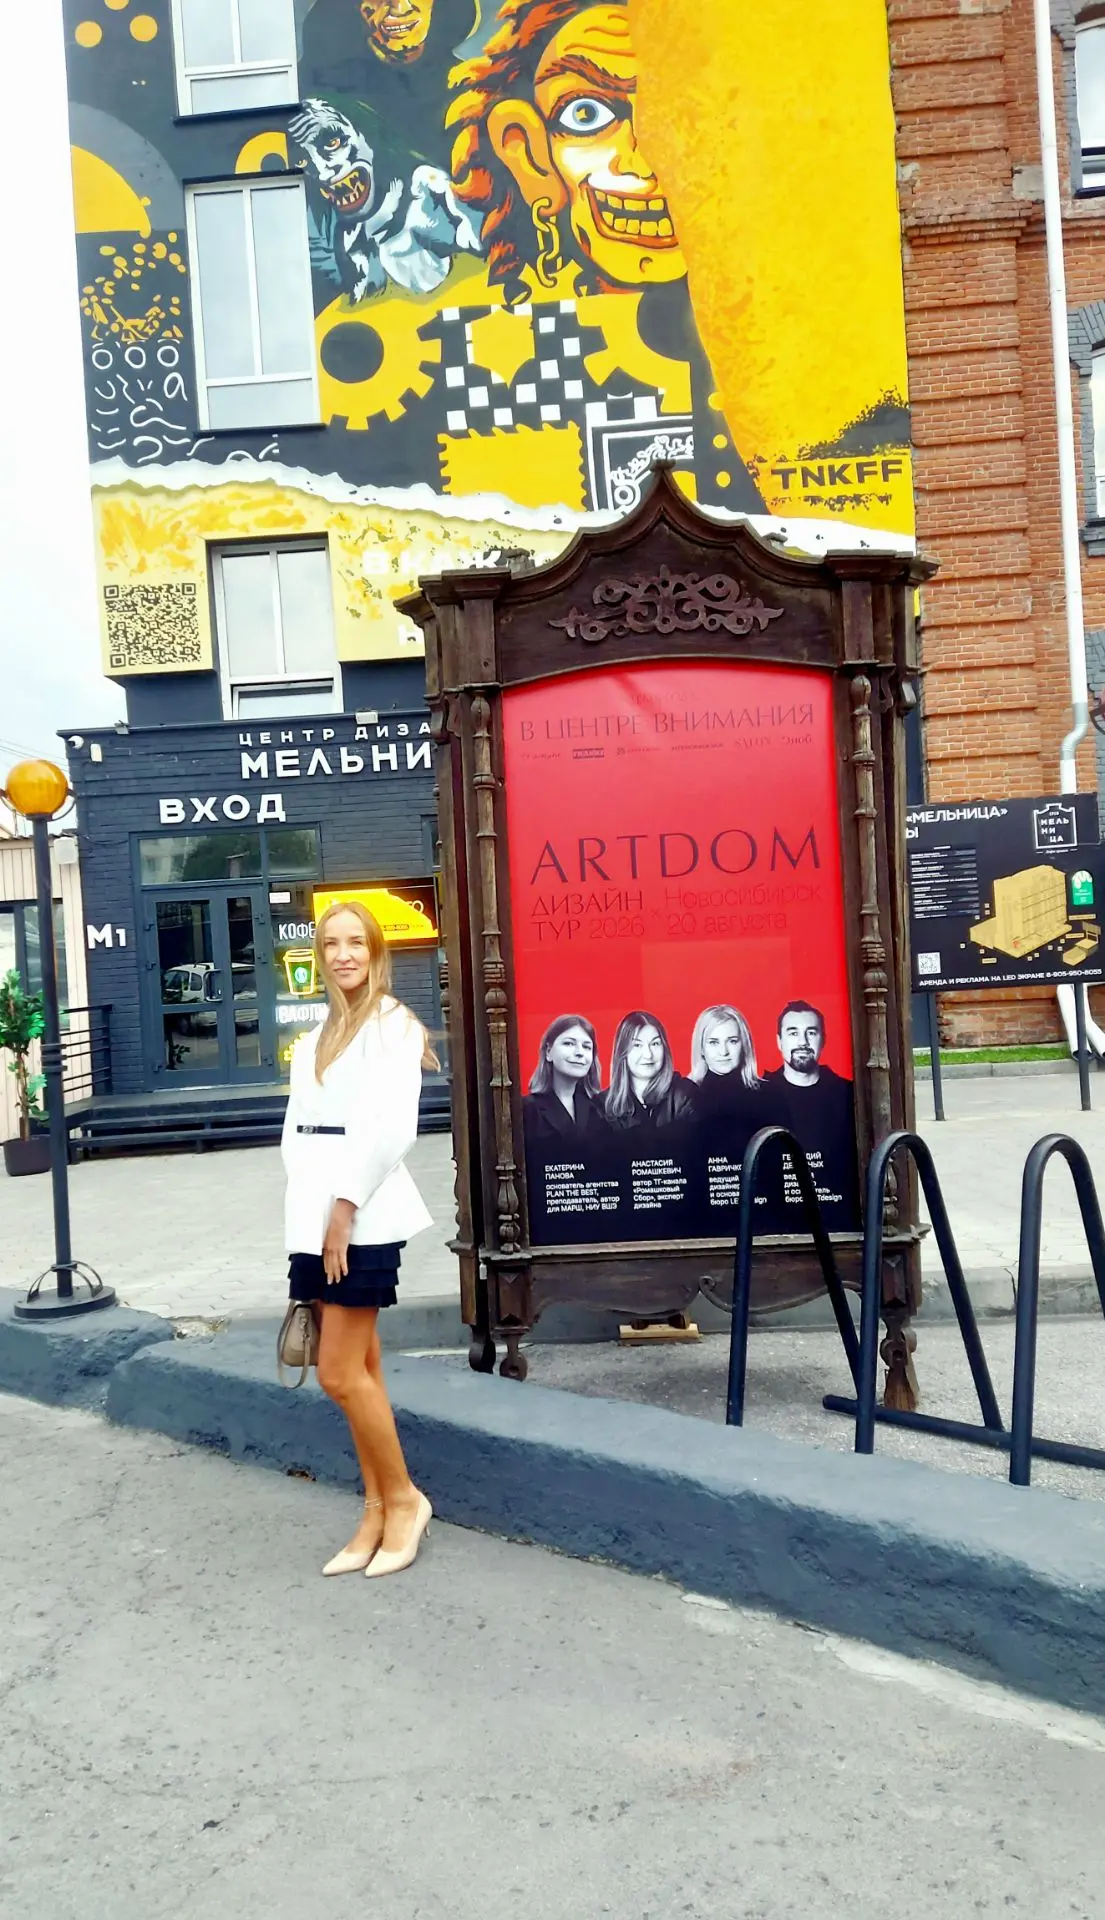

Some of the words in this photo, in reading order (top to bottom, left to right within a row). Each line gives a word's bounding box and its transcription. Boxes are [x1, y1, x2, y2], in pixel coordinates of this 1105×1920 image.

[771, 460, 902, 489] TNKFF
[521, 720, 534, 741] В
[545, 715, 643, 740] ЦЕНТРЕ
[654, 703, 813, 734] ВНИМАНИЯ
[239, 728, 335, 746] ЦЕНТР
[355, 722, 431, 740] ДИЗА
[241, 741, 432, 780] МЕЛЬНИ
[159, 794, 286, 824] ВХОД
[906, 806, 1008, 823] «МЕЛЬНИЦА»
[530, 825, 820, 885] ARTDOM
[532, 888, 643, 917] ДИЗАЙН
[665, 883, 822, 909] Новосибирск
[279, 921, 316, 940] КОФЕ
[532, 919, 581, 942] ТУР
[589, 914, 645, 939] 2026
[667, 912, 696, 936] 20
[704, 913, 787, 935] августа
[87, 923, 127, 949] М1
[956, 976, 989, 984] РЕКЛАМА
[545, 1163, 585, 1172] ЕКАТЕРИНА
[632, 1159, 673, 1167] АНАСТАСИЯ
[632, 1167, 681, 1176] РОМАШКЕВИЧ
[546, 1172, 574, 1180] ПАНОВА
[709, 1175, 740, 1183] ведущий
[547, 1190, 564, 1198] PLAN
[581, 1188, 599, 1196] BEST,
[547, 1198, 599, 1206] преподаватель,
[710, 1198, 729, 1206] бюро
[561, 1204, 584, 1212] МАРШ,
[633, 1202, 662, 1210] дизайна
